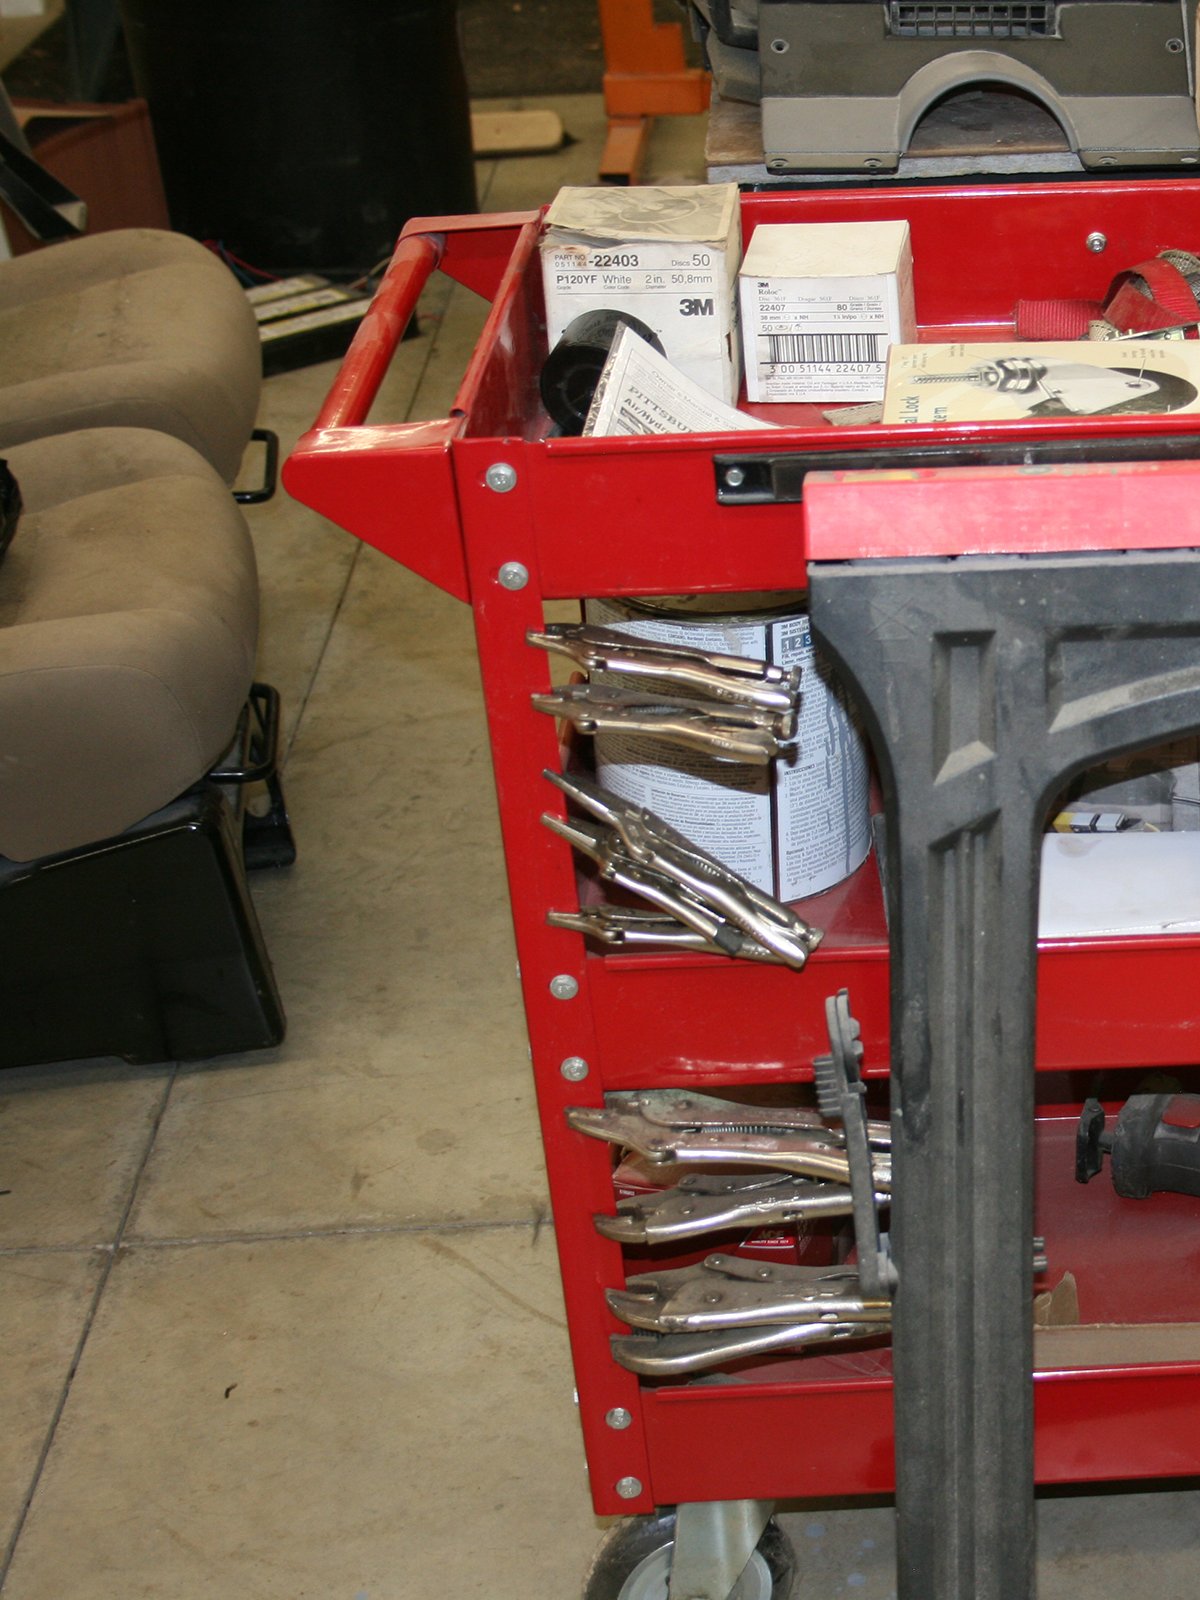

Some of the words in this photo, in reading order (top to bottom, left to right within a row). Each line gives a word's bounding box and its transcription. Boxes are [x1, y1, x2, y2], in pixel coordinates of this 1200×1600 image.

[671, 259, 691, 267] Discs
[692, 253, 711, 267] 50
[556, 274, 598, 285] P120YF
[602, 274, 632, 284] White
[645, 274, 653, 285] 2
[671, 274, 713, 285] 50,8mm
[679, 298, 714, 316] 3M
[760, 304, 786, 312] 22407
[836, 303, 848, 311] 80
[762, 324, 773, 332] 50
[769, 364, 776, 374] 3
[780, 364, 796, 374] 00
[799, 364, 831, 373] 51144
[836, 364, 871, 373] 22407
[876, 364, 882, 373] 5
[899, 395, 920, 414] Lock
